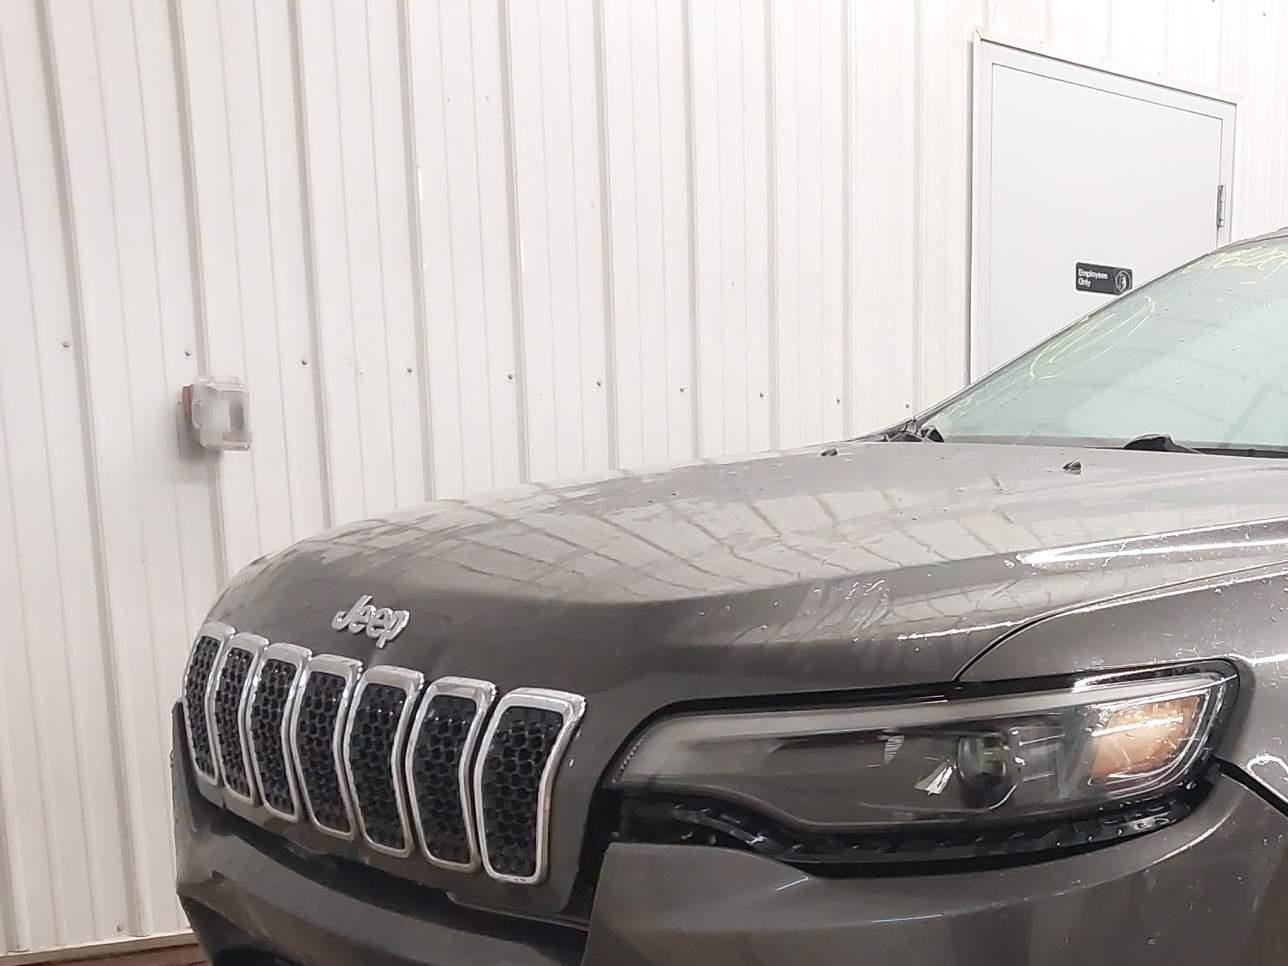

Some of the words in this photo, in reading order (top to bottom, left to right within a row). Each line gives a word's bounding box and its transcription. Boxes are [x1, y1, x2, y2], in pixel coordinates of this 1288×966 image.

[1078, 269, 1108, 279] Employees
[1078, 278, 1092, 287] Only
[331, 594, 410, 648] Jeep
